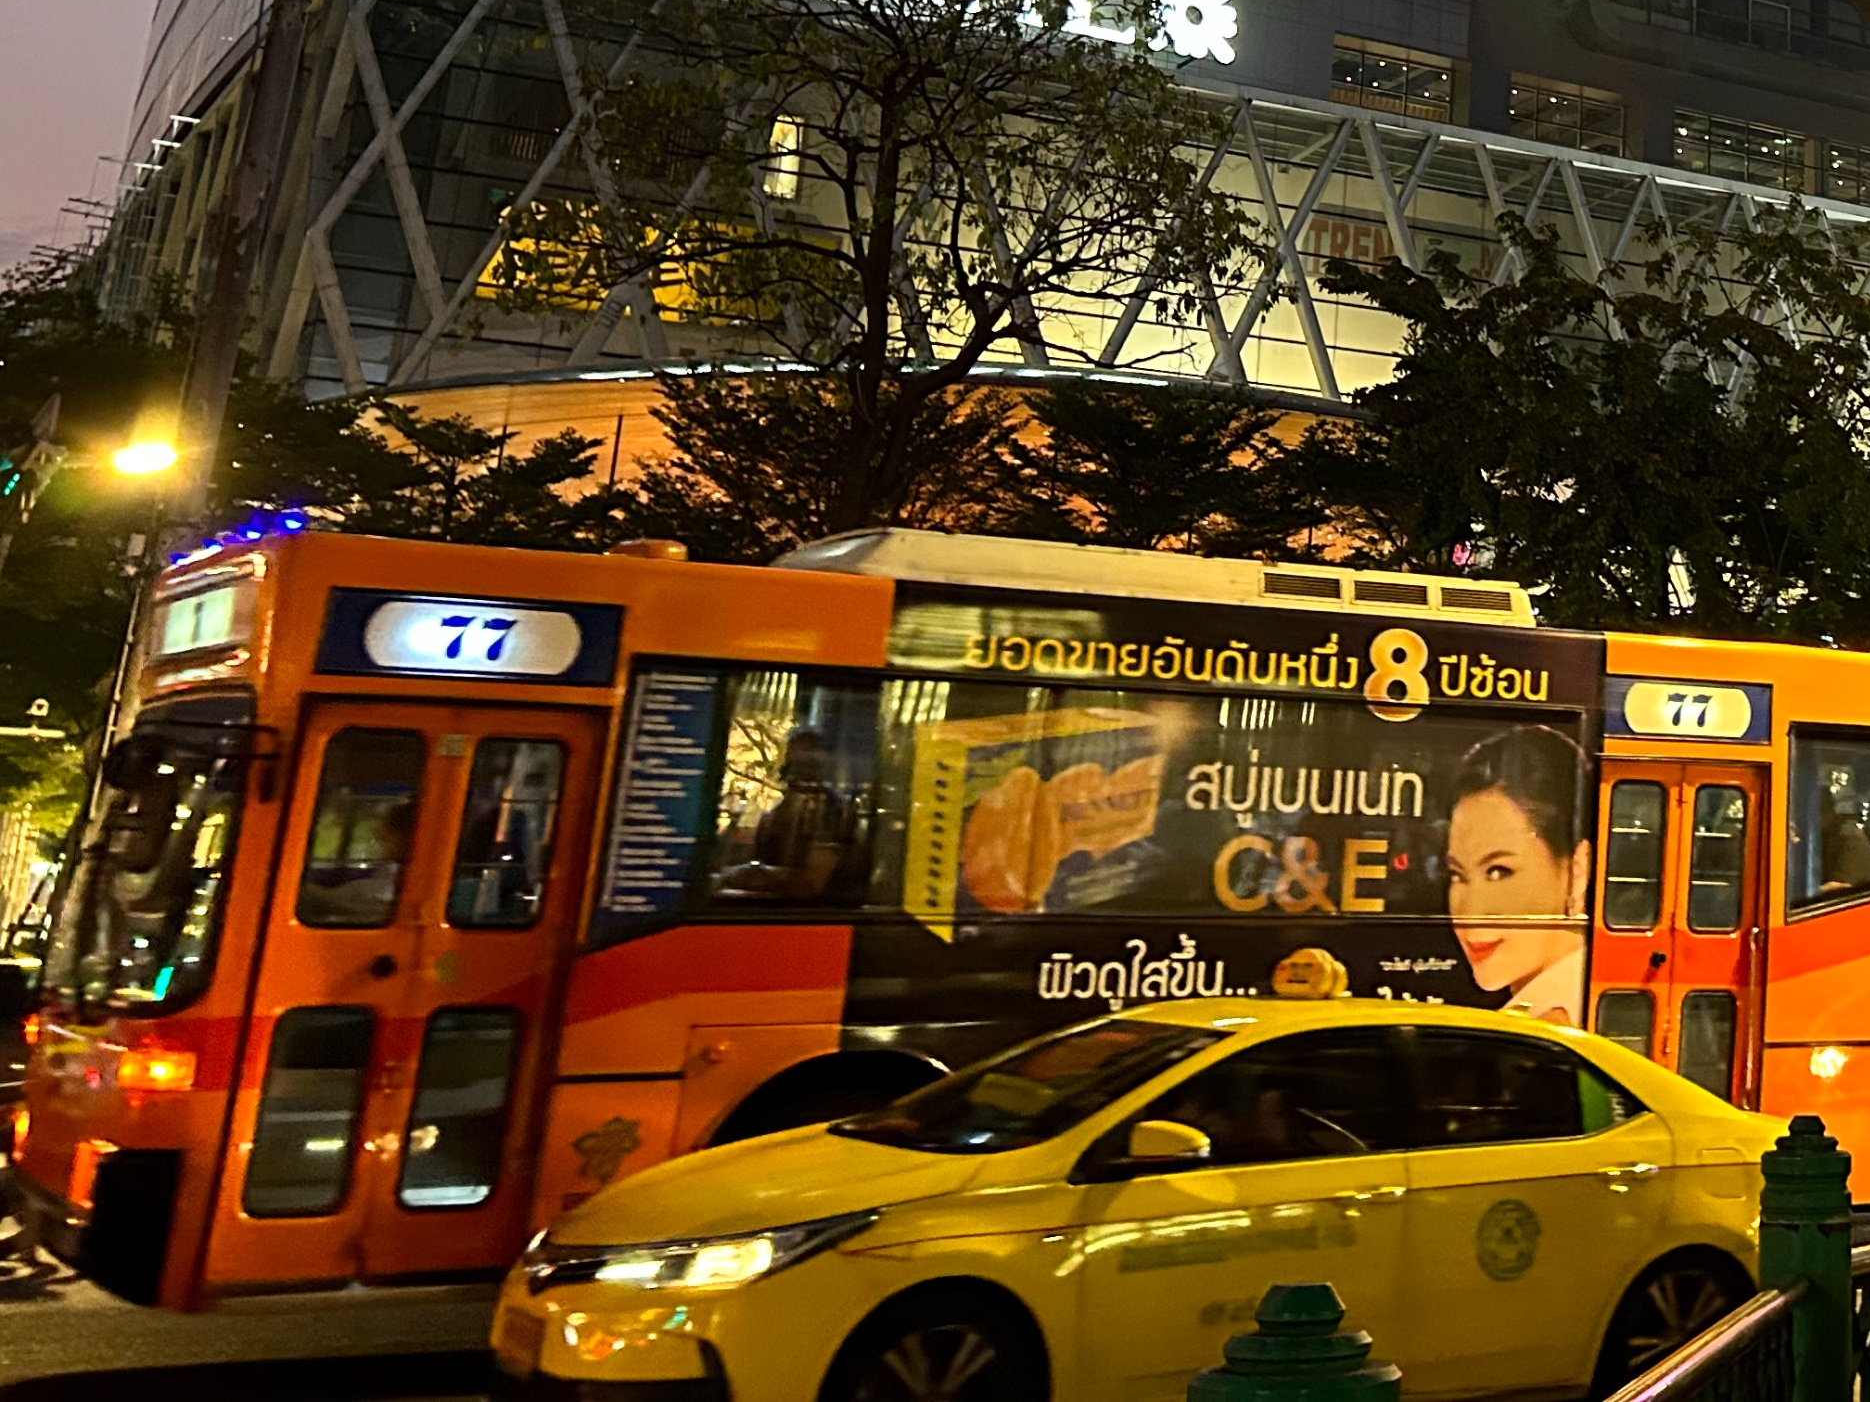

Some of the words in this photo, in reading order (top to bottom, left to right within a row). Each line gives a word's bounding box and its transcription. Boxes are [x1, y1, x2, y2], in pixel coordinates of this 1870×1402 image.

[440, 615, 519, 662] 77
[1364, 628, 1430, 722] 8
[1439, 652, 1549, 702] ปีซ้อน
[1666, 692, 1714, 728] 77
[1213, 833, 1390, 914] C&E
